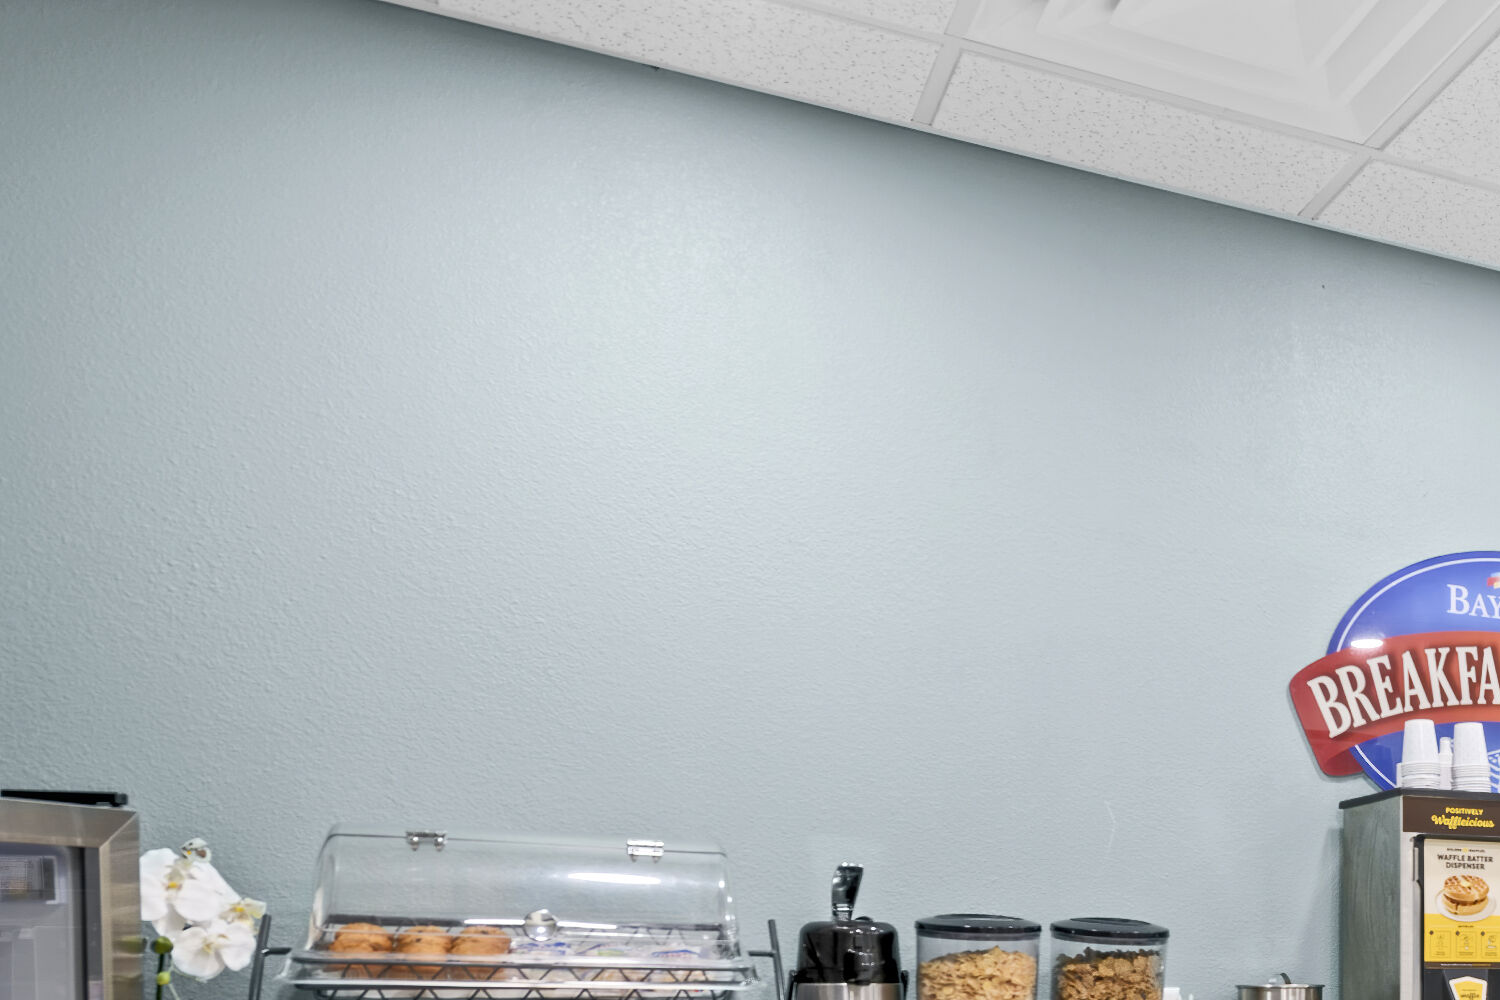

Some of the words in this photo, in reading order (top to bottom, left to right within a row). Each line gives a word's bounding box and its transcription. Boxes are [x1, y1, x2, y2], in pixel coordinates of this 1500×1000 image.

[1445, 806, 1484, 816] POSITIVELY
[1467, 855, 1494, 863] BATTER
[1445, 862, 1486, 870] DISPENSER
